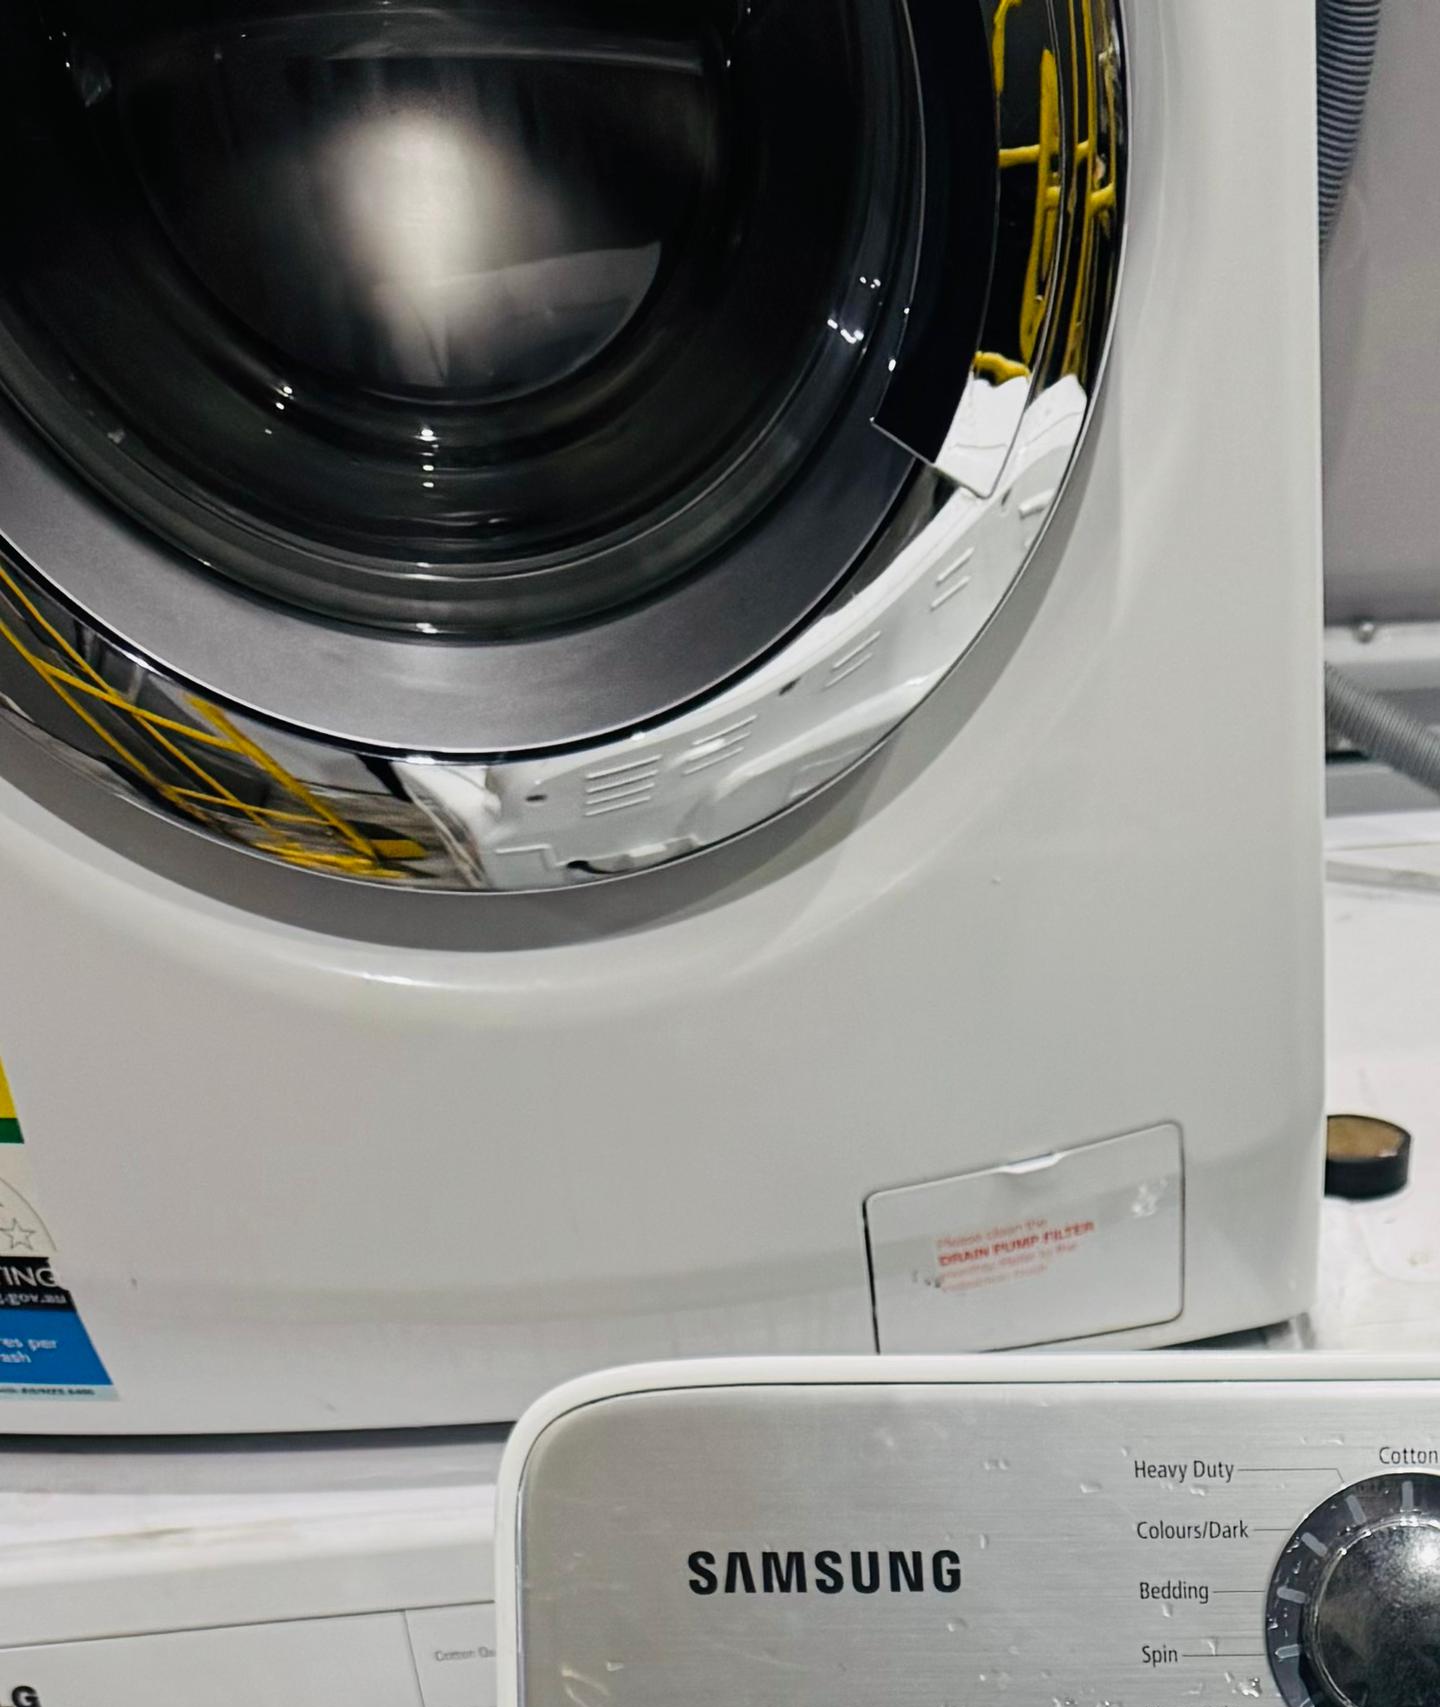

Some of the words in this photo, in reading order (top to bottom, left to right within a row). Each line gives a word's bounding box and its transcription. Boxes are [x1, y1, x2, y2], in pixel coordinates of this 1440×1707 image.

[938, 1247, 990, 1266] DRAIN
[992, 1234, 1041, 1256] PUMP
[1043, 1220, 1096, 1244] FILTER
[0, 1266, 58, 1288] ING
[1378, 1446, 1439, 1466] Cotton
[1134, 1460, 1188, 1483] Heavy
[1193, 1460, 1235, 1483] Duty
[1136, 1520, 1249, 1540] Colours/Dark
[688, 1549, 962, 1595] SAMSUNG
[1139, 1580, 1210, 1605] Bedding
[1141, 1644, 1179, 1668] Spin
